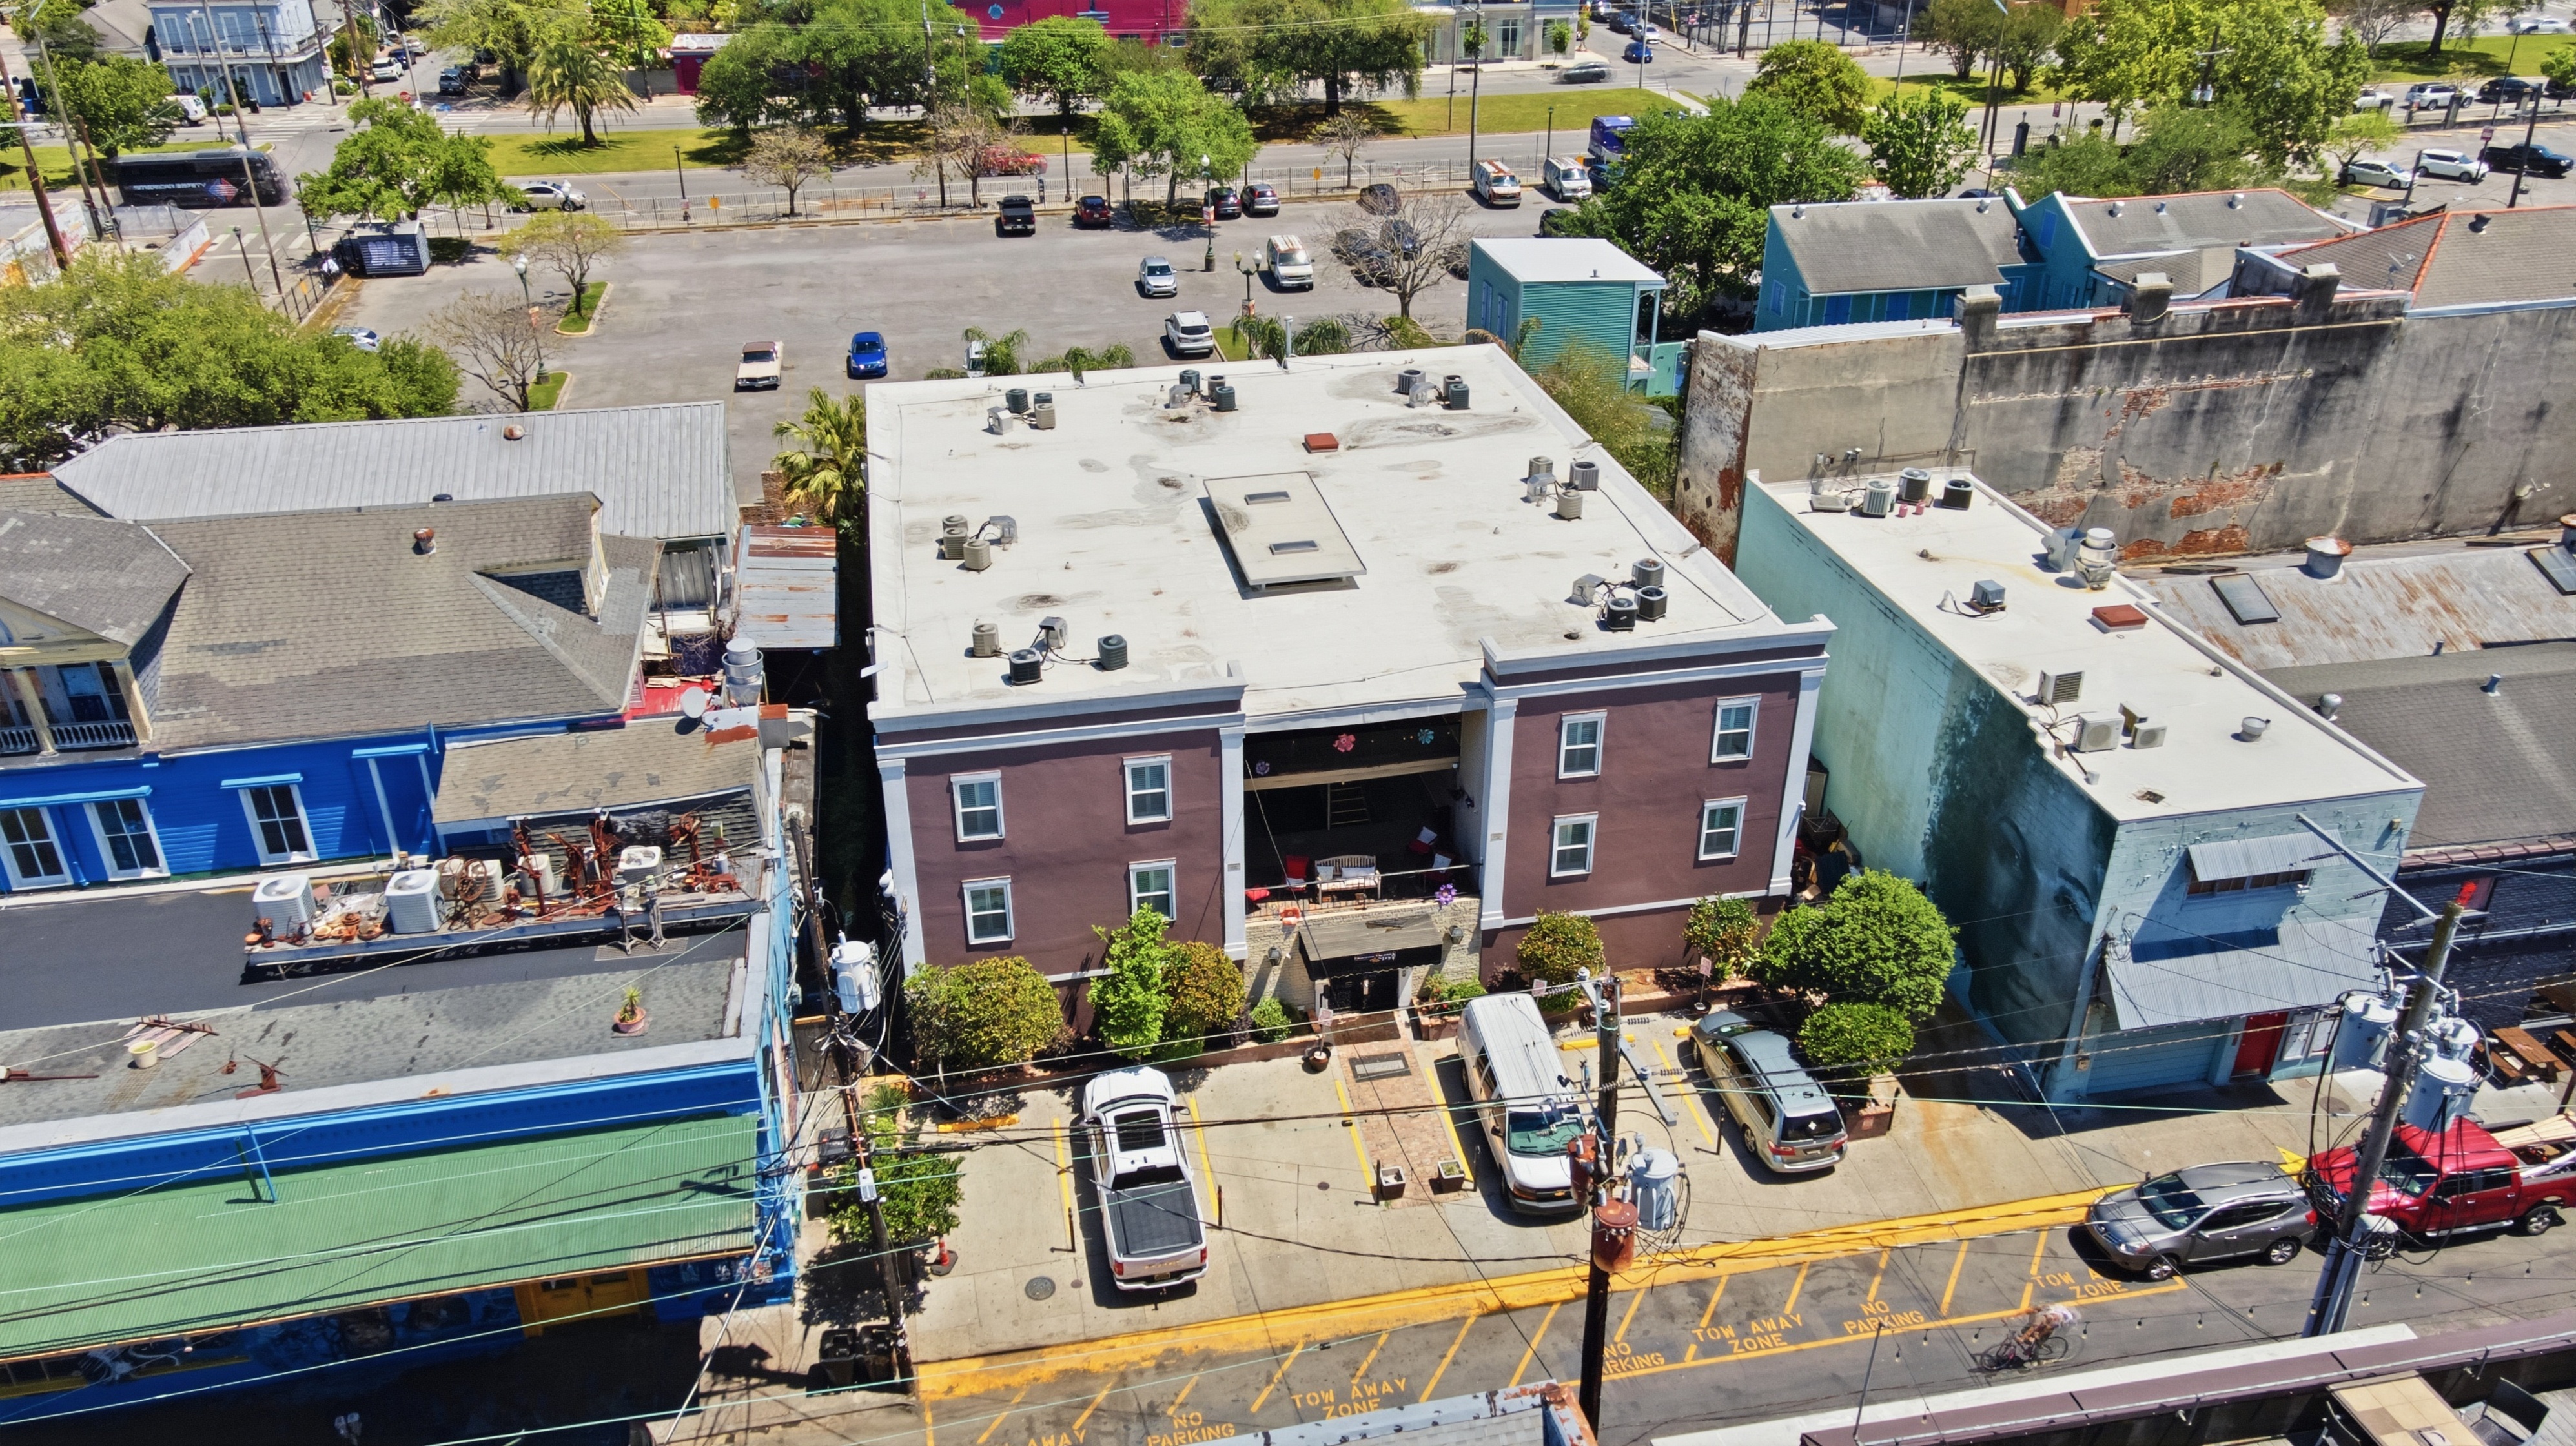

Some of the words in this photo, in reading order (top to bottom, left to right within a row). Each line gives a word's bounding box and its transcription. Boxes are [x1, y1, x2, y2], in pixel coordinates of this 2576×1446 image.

[2031, 1271, 2076, 1288] TOW
[2069, 1279, 2129, 1299] ZONE
[1859, 1300, 1890, 1316] NO
[1691, 1324, 1735, 1342] TOW
[1750, 1313, 1803, 1334] AWAY
[1843, 1310, 1925, 1334] PARKING
[1604, 1342, 1631, 1359] NO
[1728, 1333, 1788, 1353] ZONE
[1602, 1352, 1665, 1375] RKING
[1291, 1389, 1335, 1409] TOW
[1351, 1377, 1406, 1400] AWAY
[1322, 1398, 1381, 1420] ZONE
[1172, 1412, 1203, 1429] NO
[1147, 1423, 1236, 1446] PARKING
